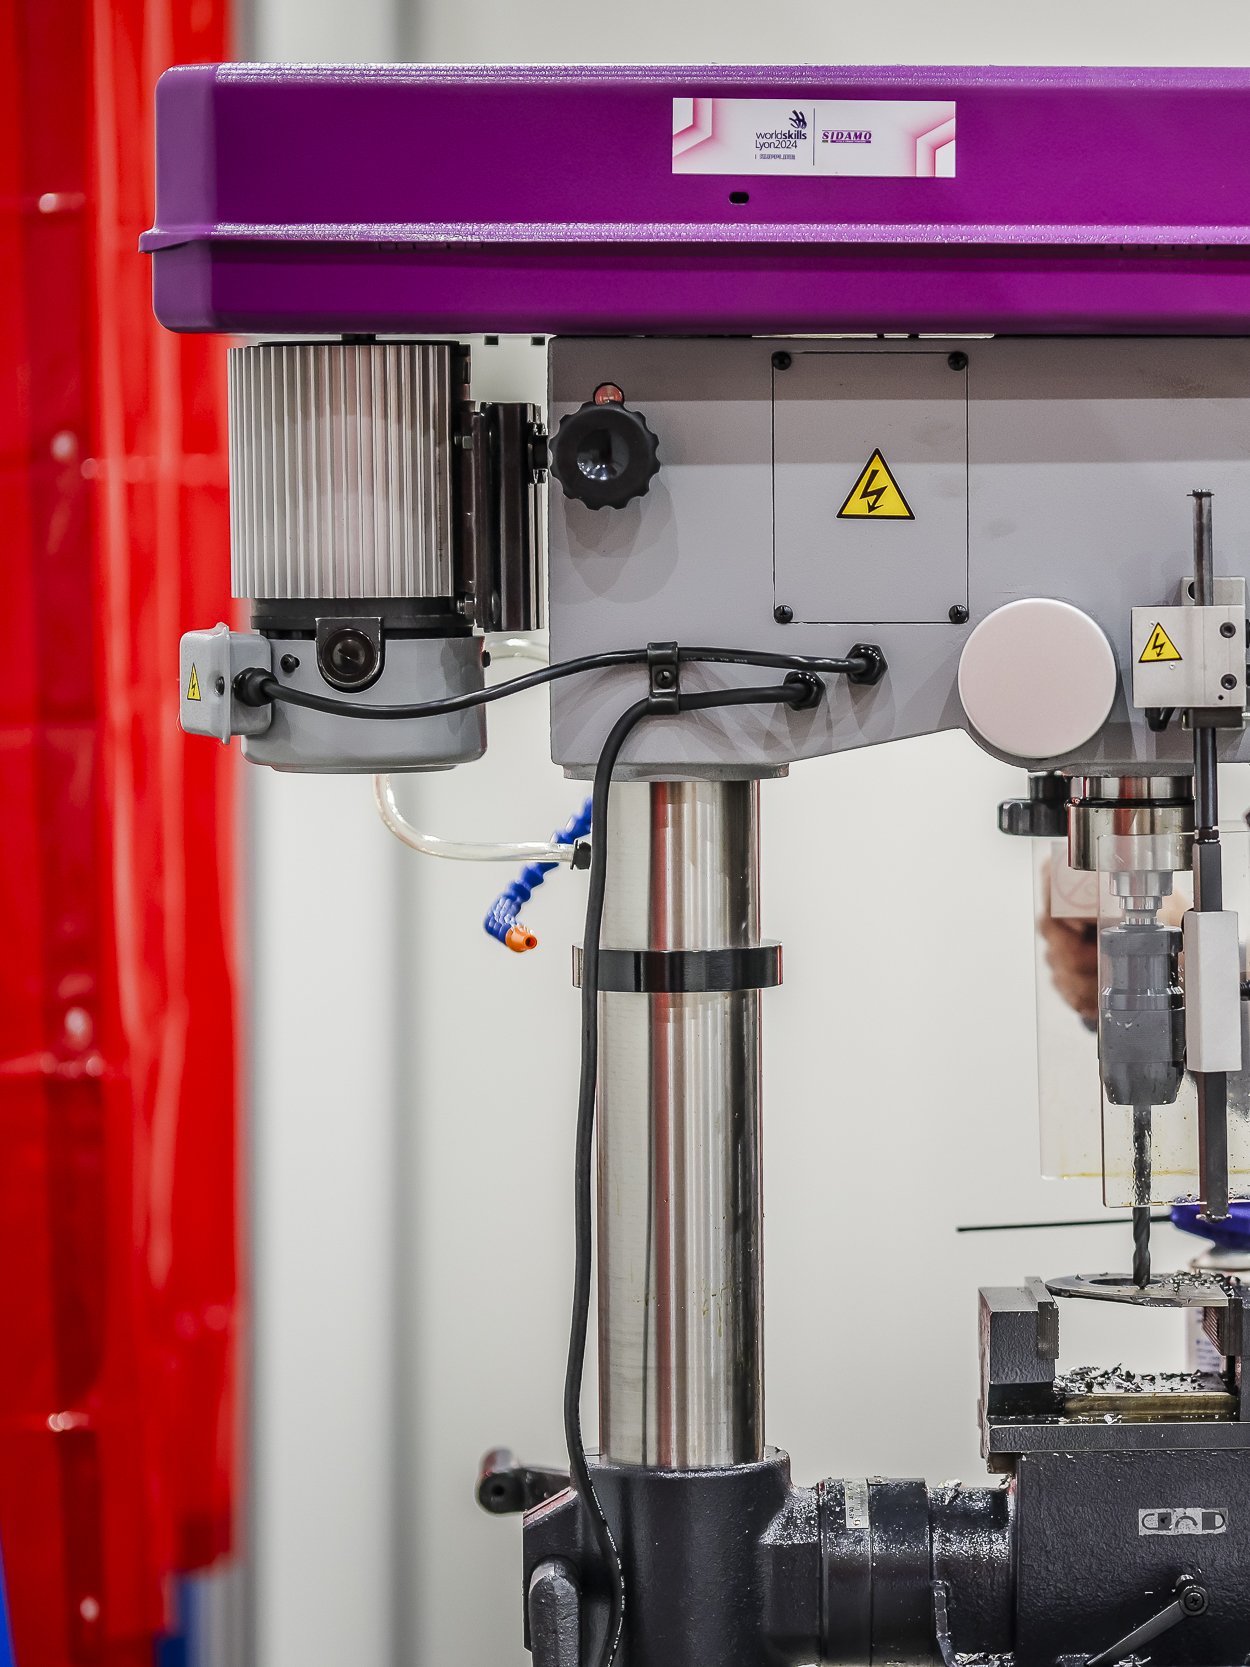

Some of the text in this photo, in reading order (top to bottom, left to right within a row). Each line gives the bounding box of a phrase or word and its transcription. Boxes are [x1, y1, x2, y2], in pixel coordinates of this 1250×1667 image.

[755, 130, 807, 140] worldskills
[821, 131, 872, 141] SIDAMO
[755, 139, 798, 151] Lyon2024
